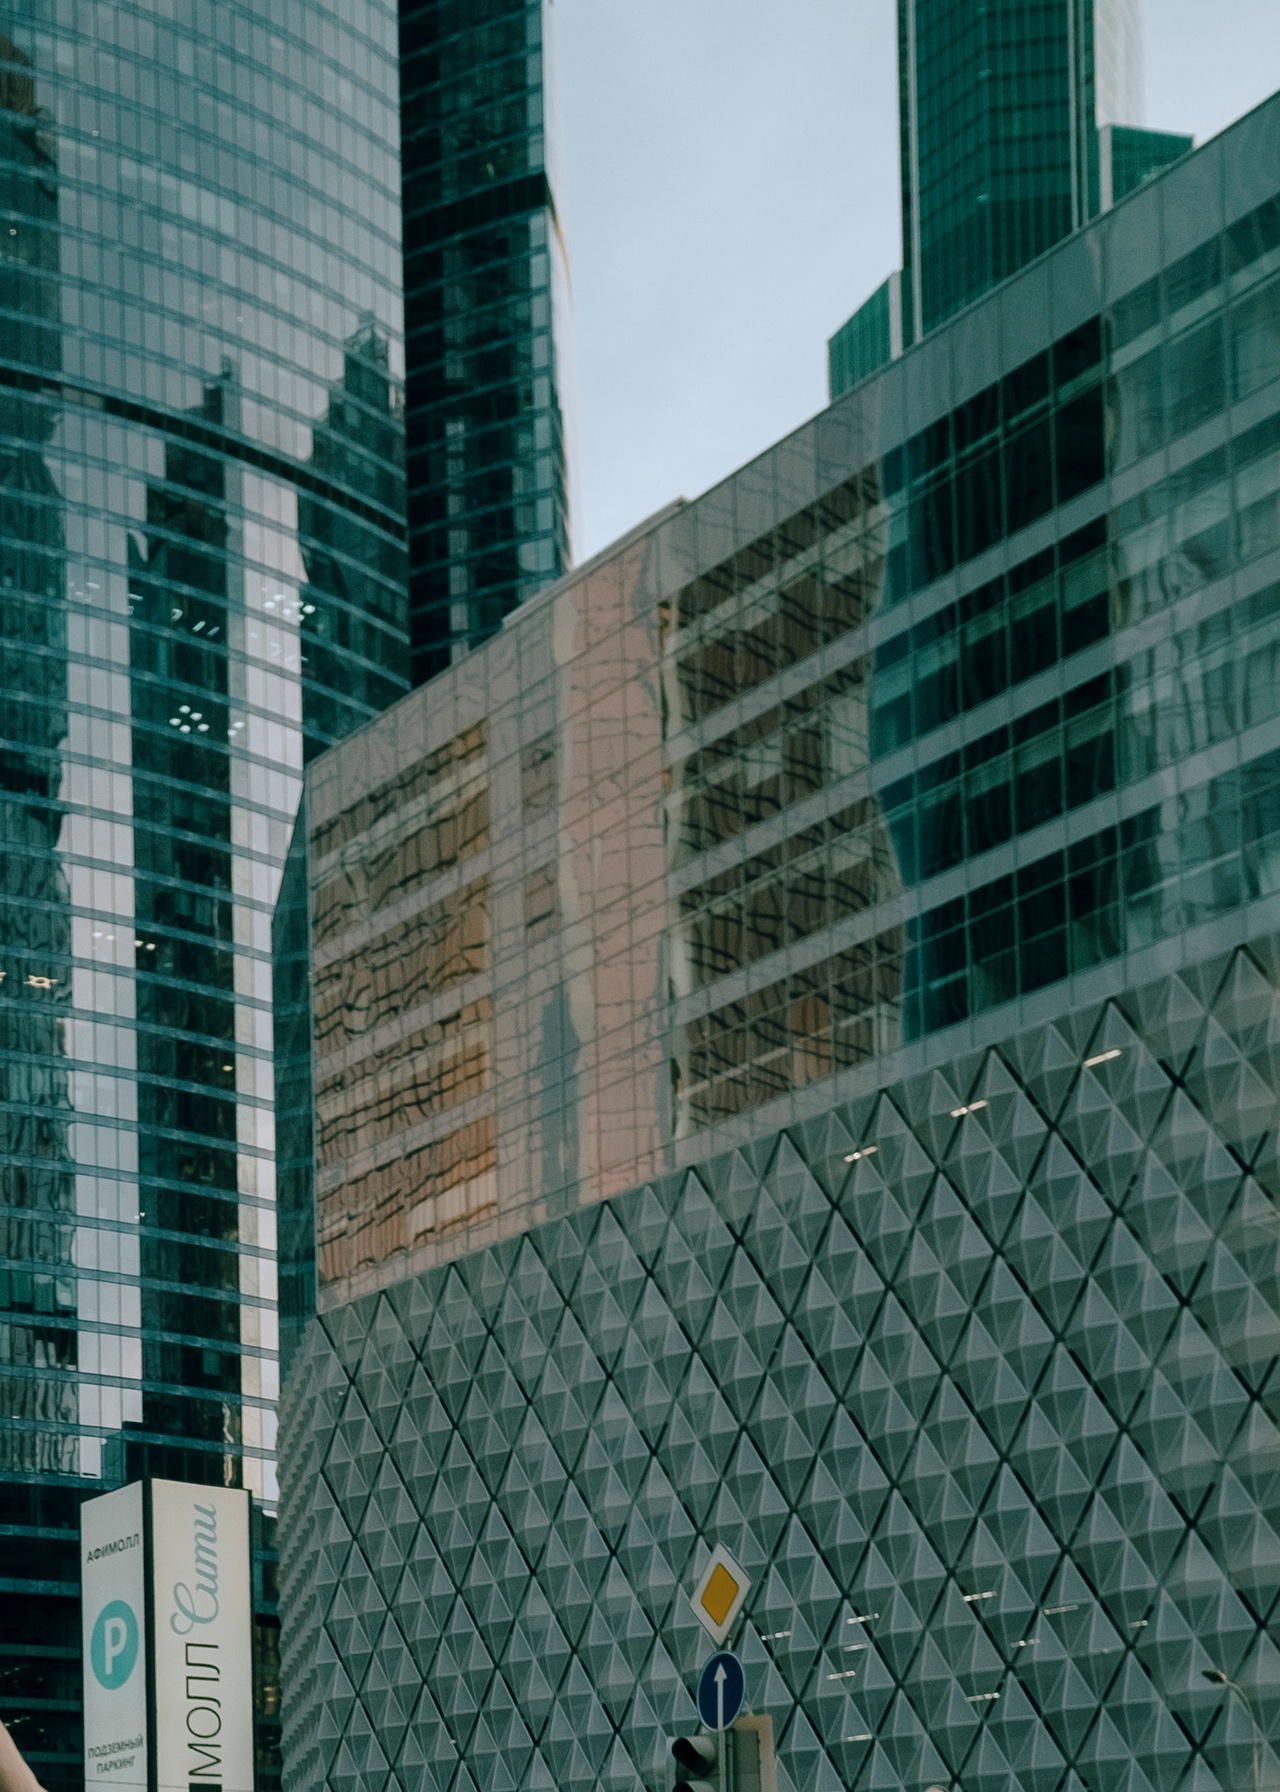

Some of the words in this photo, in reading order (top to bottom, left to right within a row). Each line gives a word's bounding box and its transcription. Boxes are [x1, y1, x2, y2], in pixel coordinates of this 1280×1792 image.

[86, 1533, 141, 1564] АФИМОЛЛ
[170, 1503, 220, 1636] Сити
[87, 1733, 144, 1759] ПОДЗЕМНЫЙ
[96, 1755, 136, 1774] ПАРКИНГ
